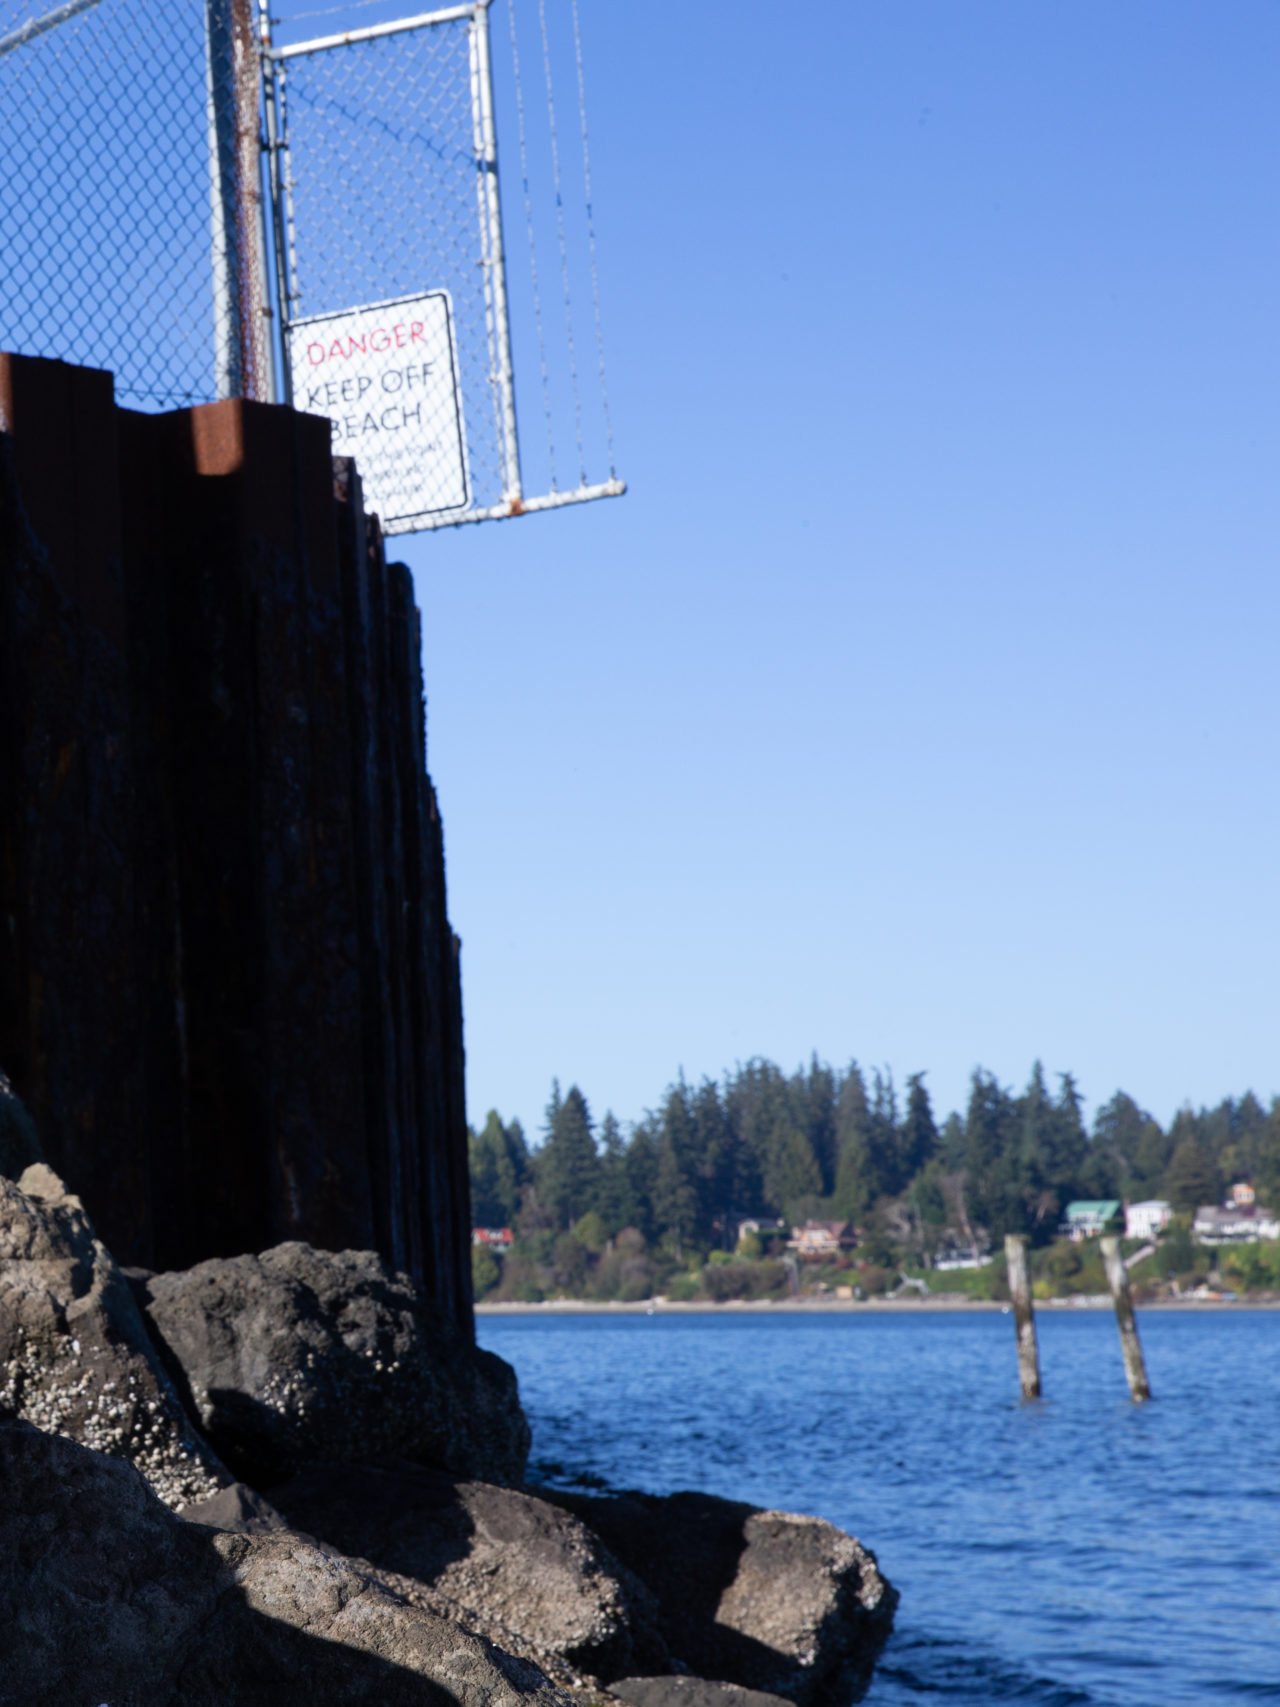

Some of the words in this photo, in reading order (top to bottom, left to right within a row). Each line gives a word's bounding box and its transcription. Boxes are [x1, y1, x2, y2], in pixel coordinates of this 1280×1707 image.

[307, 322, 426, 365] DANGER
[307, 376, 371, 408] KEEP
[381, 361, 434, 394] OFF
[331, 402, 422, 442] BEACH
